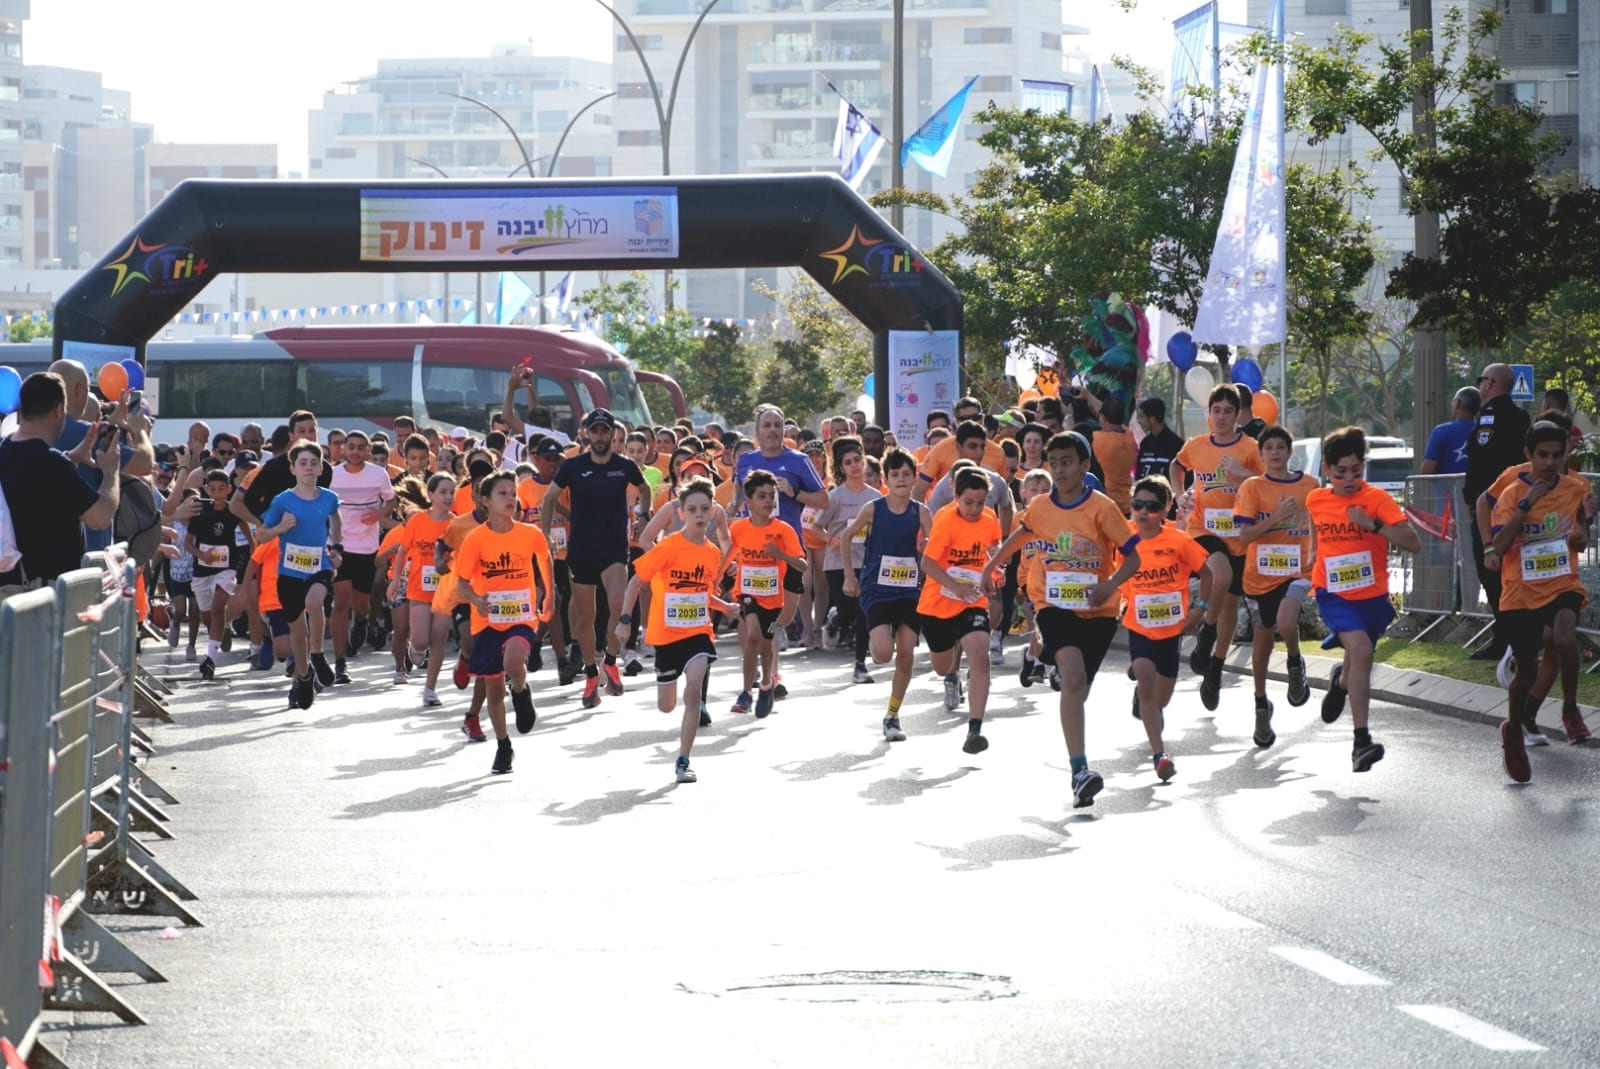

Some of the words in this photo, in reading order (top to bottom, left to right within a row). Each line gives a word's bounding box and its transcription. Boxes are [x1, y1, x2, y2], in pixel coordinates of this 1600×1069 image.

[497, 219, 544, 236] יבנה
[564, 217, 609, 239] מרוץ
[379, 220, 485, 258] זינוק
[900, 358, 922, 367] יבנה
[671, 569, 694, 580] יבנה
[890, 569, 909, 579] 2144
[1339, 569, 1361, 582] 2021
[1060, 588, 1084, 599] 2096
[501, 604, 521, 615] 2024
[678, 607, 698, 618] 2033
[1149, 607, 1170, 619] 2004
